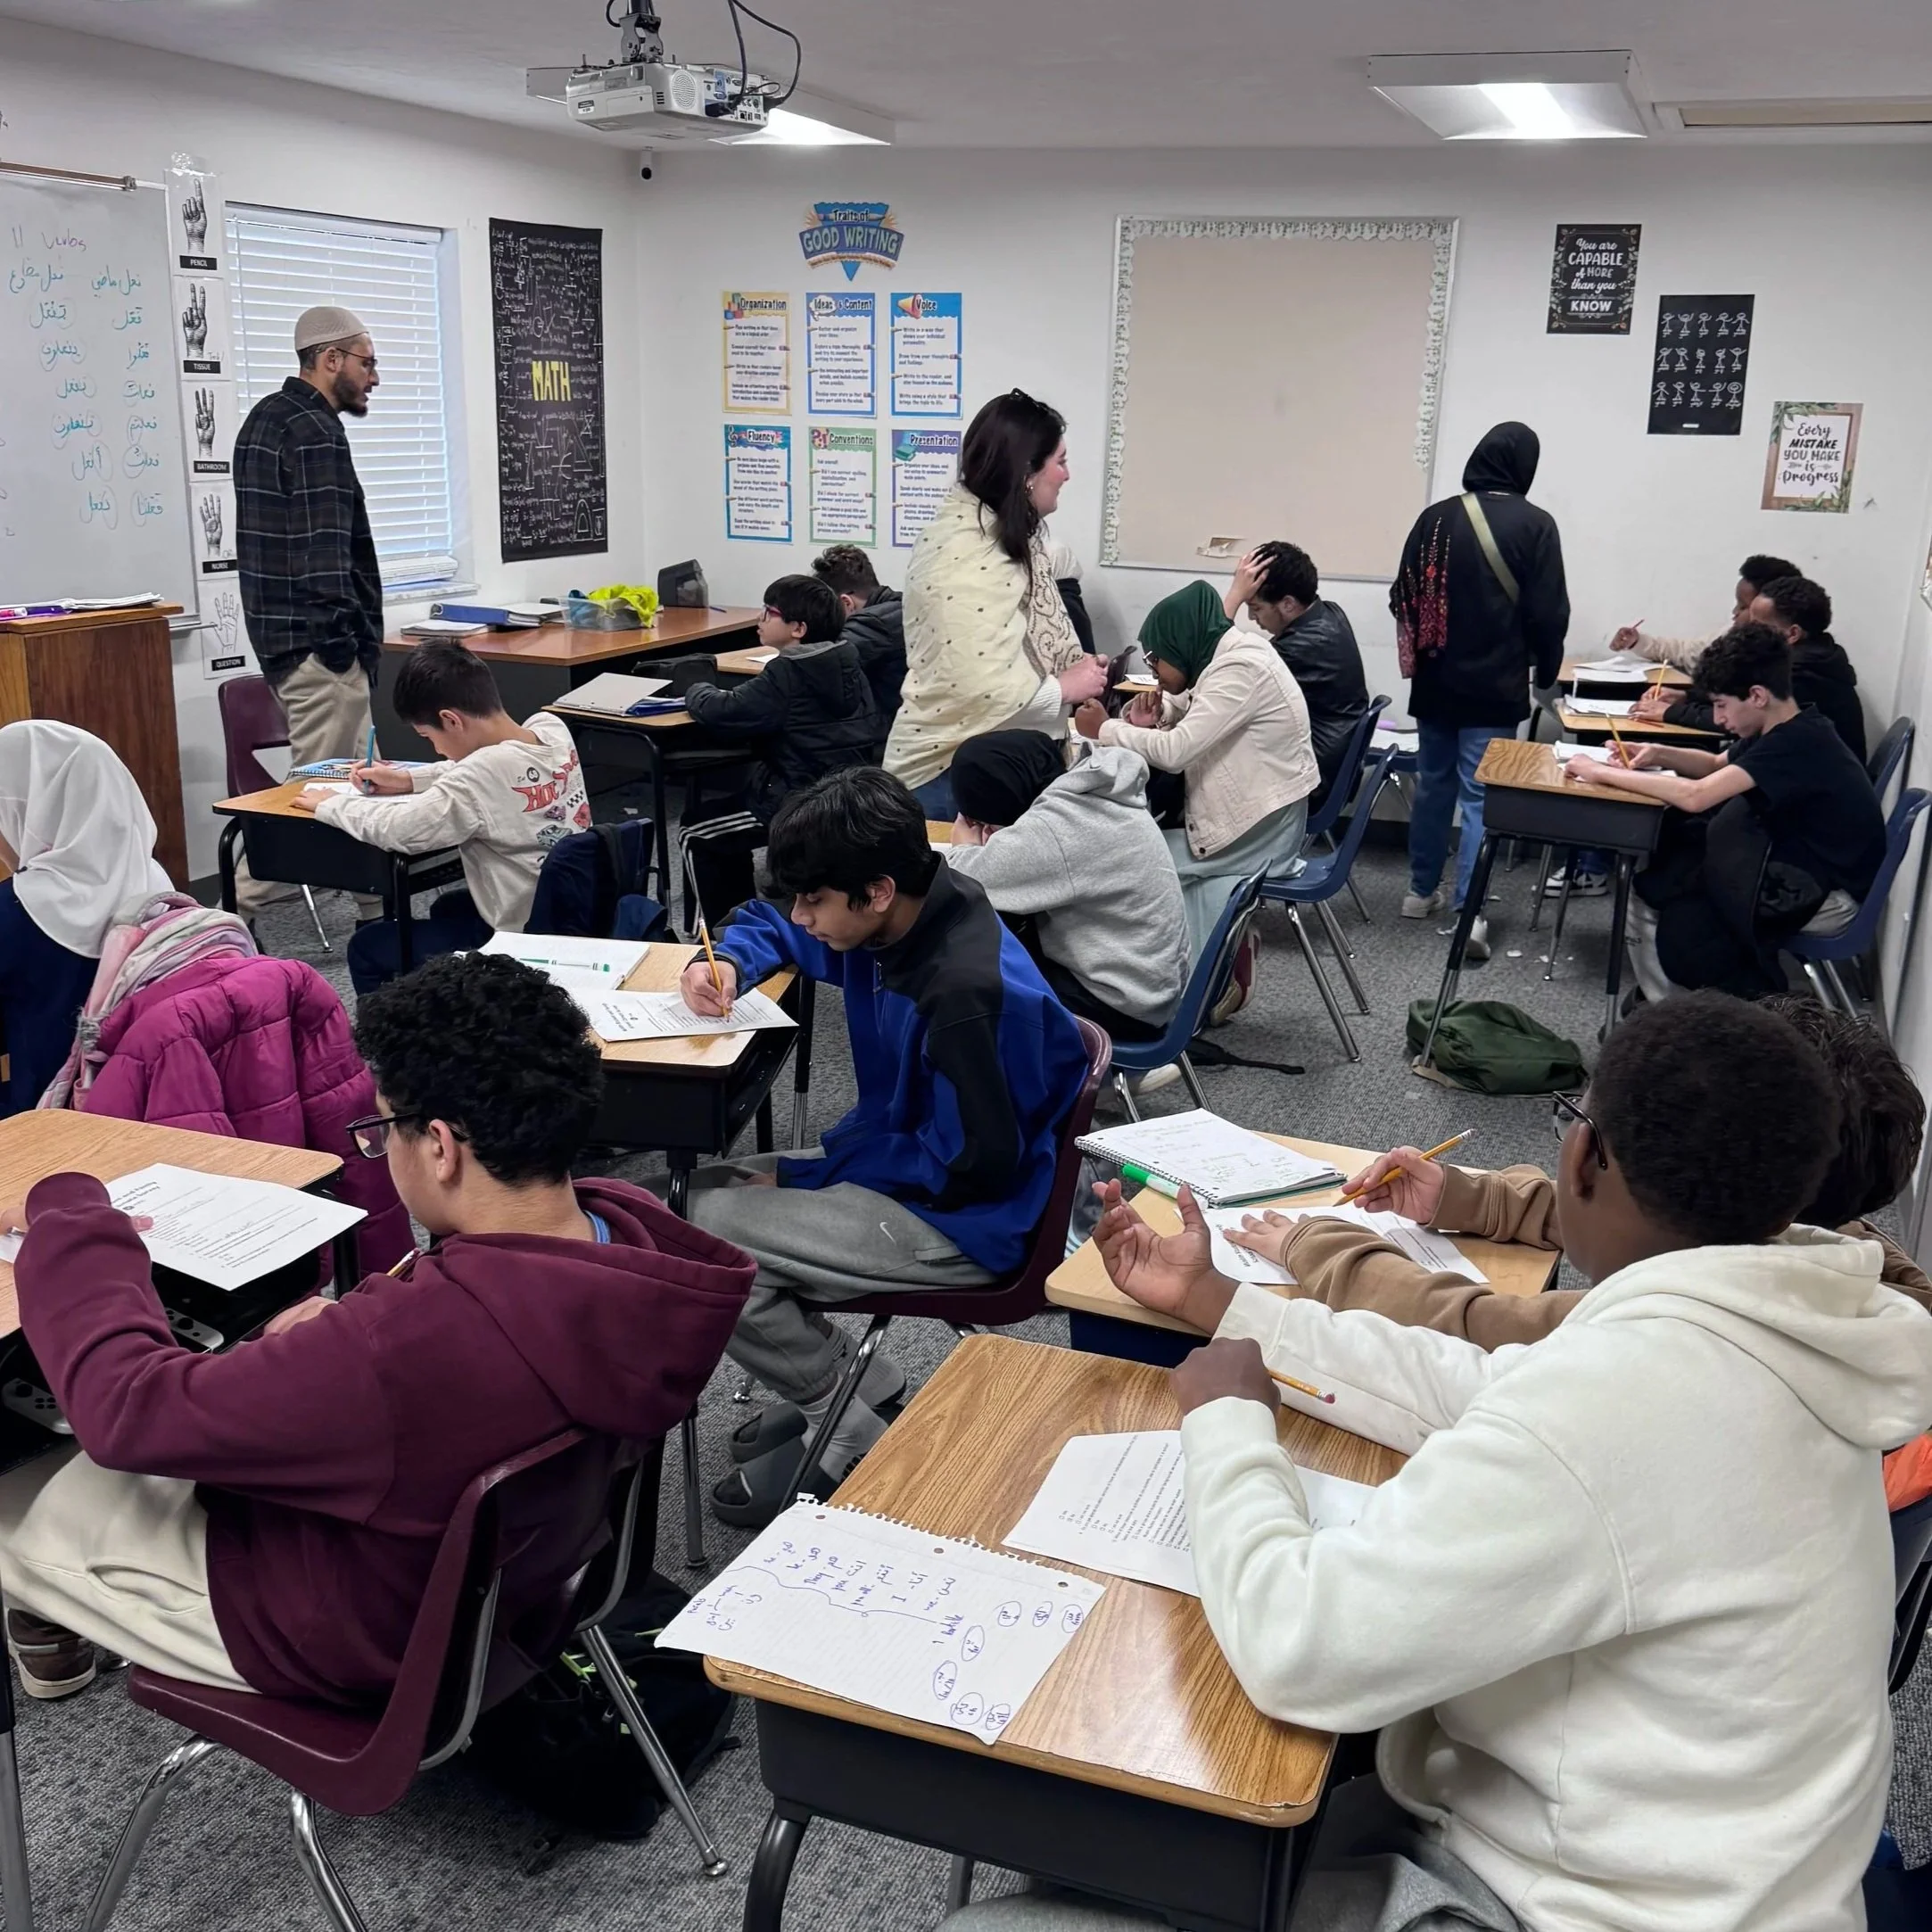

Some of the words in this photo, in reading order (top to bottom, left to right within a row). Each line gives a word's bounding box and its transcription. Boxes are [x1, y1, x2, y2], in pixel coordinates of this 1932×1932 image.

[833, 210, 858, 221] Traits
[859, 210, 870, 221] of
[803, 227, 839, 252] GOOD
[843, 226, 898, 253] WRITING
[1575, 237, 1598, 251] You
[1598, 242, 1618, 250] are
[190, 259, 208, 267] PENCIL
[1568, 252, 1623, 266] CAPABLE
[1575, 267, 1586, 278] of
[1587, 268, 1614, 278] MORE
[1571, 278, 1596, 289] than
[1596, 282, 1618, 293] you
[740, 297, 787, 311] Organization
[813, 299, 833, 310] Ideas
[844, 298, 872, 310] Content
[916, 299, 937, 310] Voice
[1571, 300, 1612, 311] KNOW
[193, 363, 211, 371] TISSUE
[532, 360, 572, 401] MATH
[748, 431, 775, 442] Fluency
[1797, 423, 1830, 439] Every
[829, 433, 873, 444] Conventions
[910, 434, 958, 446] Presentation
[1788, 438, 1838, 449] MISTAKE
[1784, 450, 1808, 460] YOU
[1811, 450, 1841, 461] MAKE
[196, 463, 227, 471] BATHROOM
[1804, 460, 1815, 472] is
[216, 658, 241, 667] QUESTION
